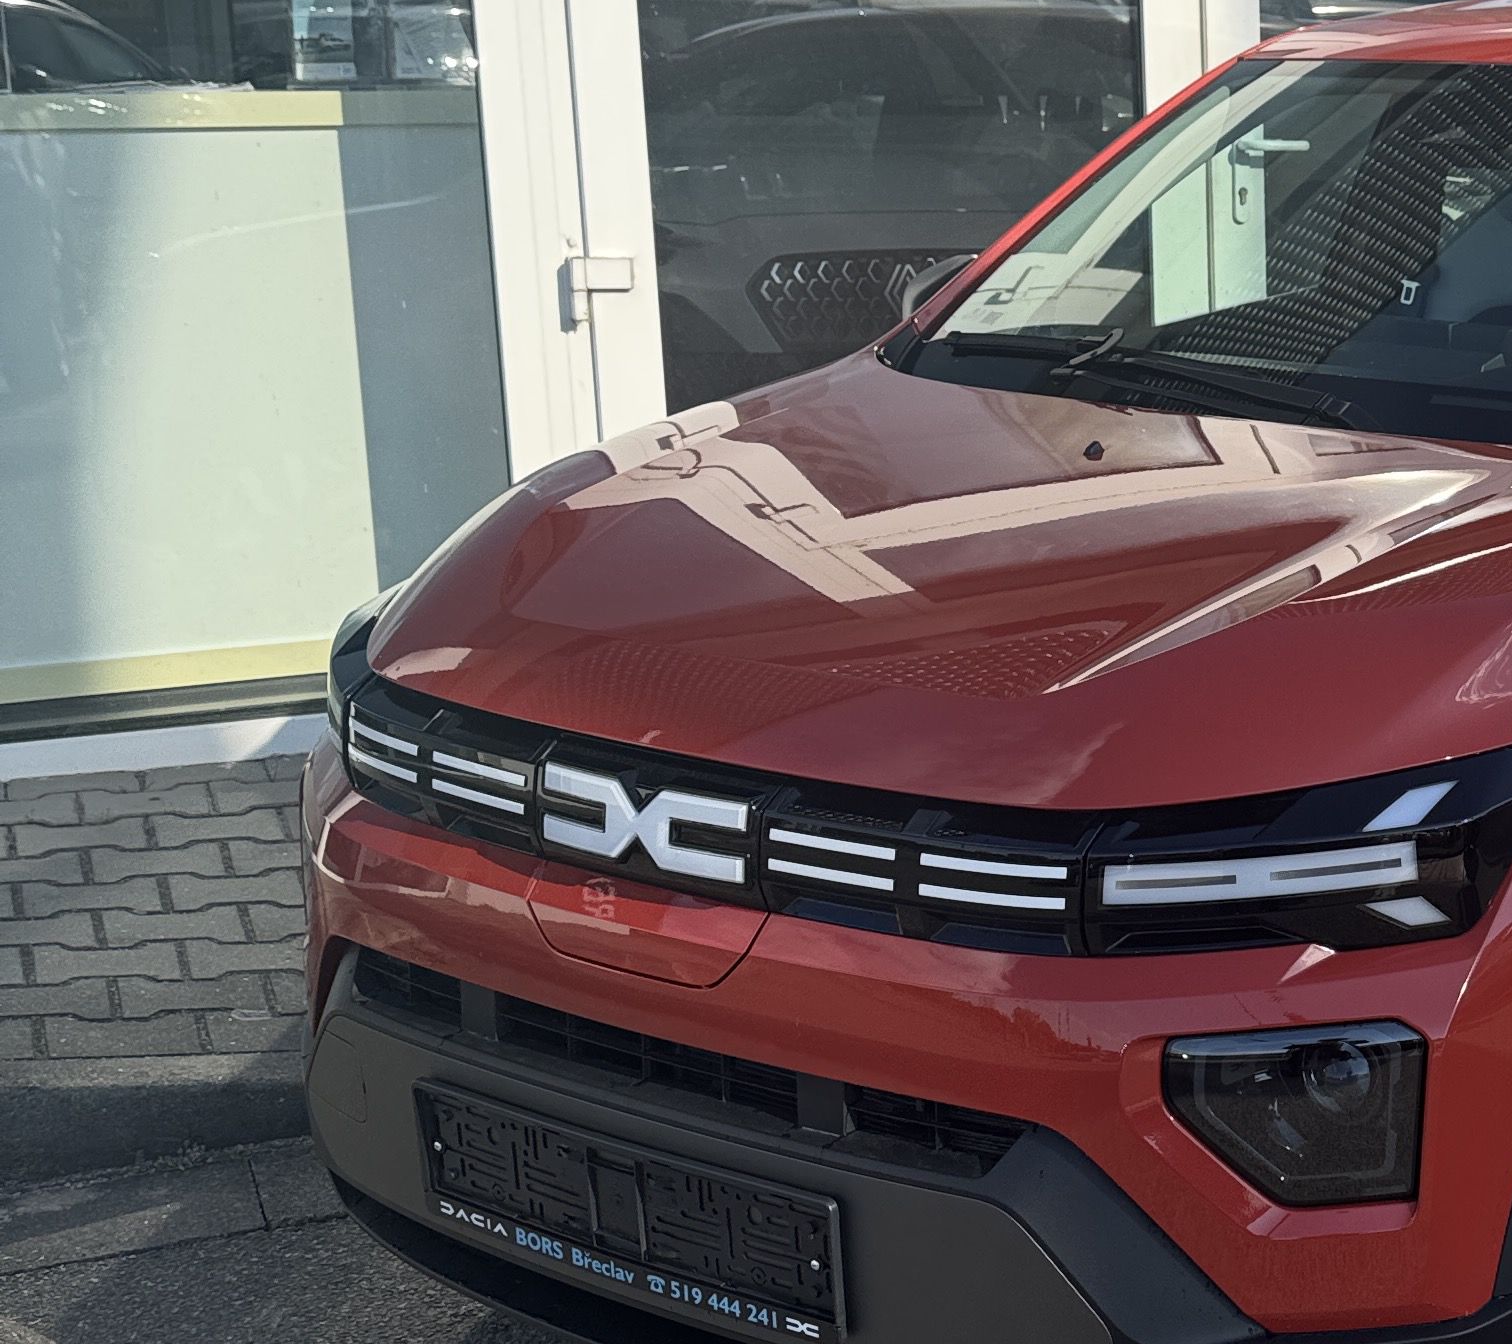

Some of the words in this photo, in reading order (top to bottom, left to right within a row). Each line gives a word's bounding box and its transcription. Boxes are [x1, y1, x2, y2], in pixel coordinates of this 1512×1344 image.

[440, 1200, 508, 1238] DACIA
[515, 1227, 564, 1260] BORS
[571, 1246, 635, 1285] Břeclav
[670, 1279, 703, 1306] 519
[708, 1293, 741, 1319] 444
[746, 1304, 778, 1330] 241
